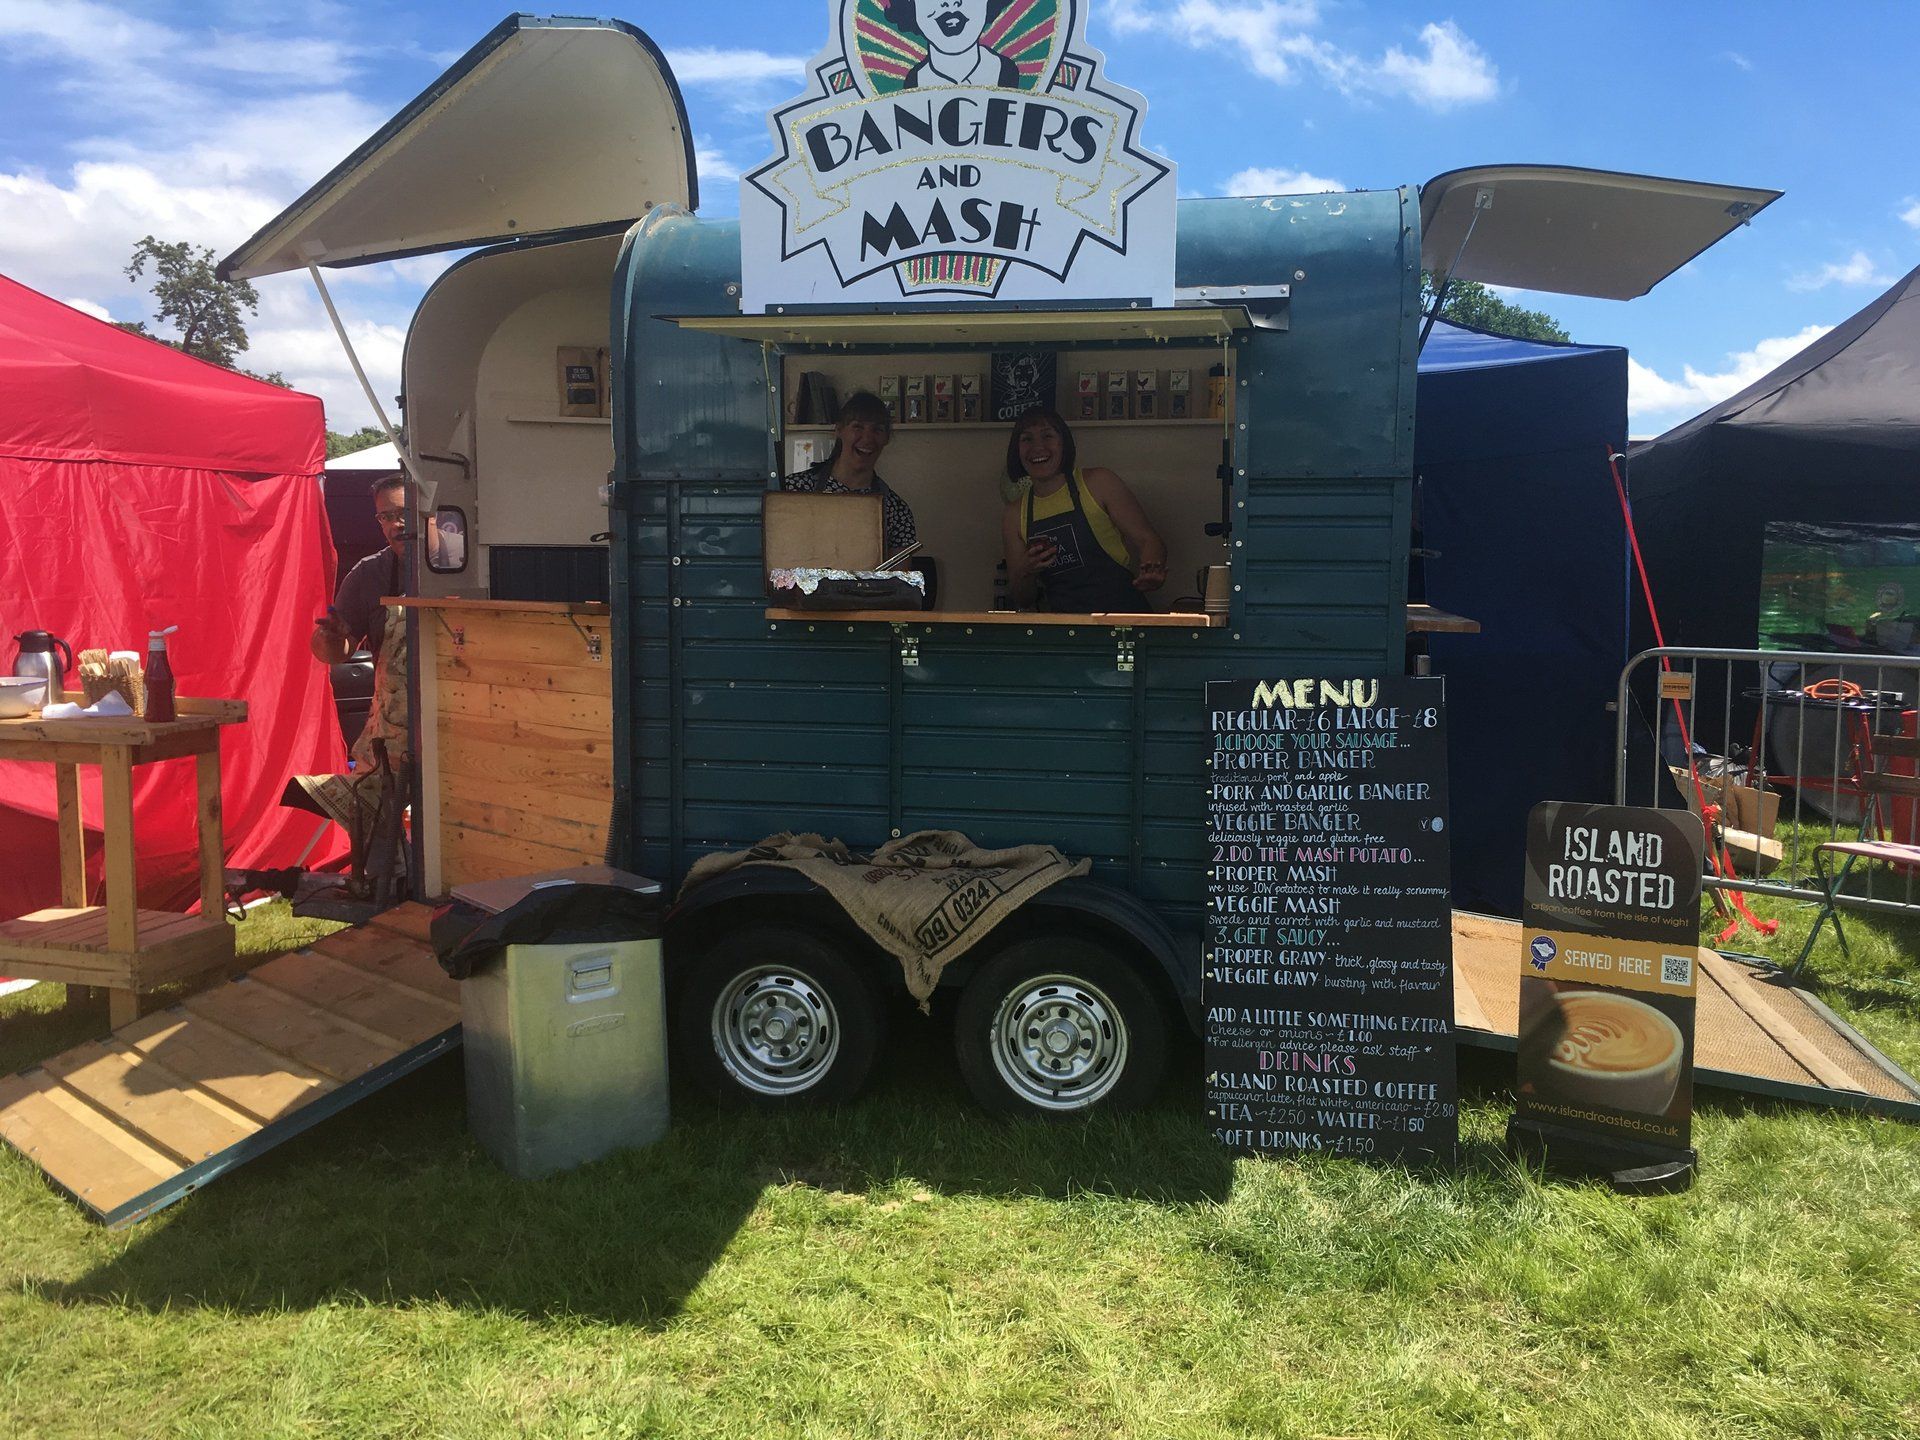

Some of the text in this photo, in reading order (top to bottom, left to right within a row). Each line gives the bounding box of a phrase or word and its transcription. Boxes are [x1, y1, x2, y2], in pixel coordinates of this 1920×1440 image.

[805, 97, 1103, 173] BANGERS
[916, 164, 981, 190] AND
[861, 197, 1041, 262] MASH
[1252, 679, 1378, 709] MENU
[1291, 733, 1329, 750] YOUR
[1213, 750, 1376, 770] PROPER BANGER
[1267, 772, 1292, 785] pork
[1295, 770, 1315, 780] and
[1318, 770, 1348, 783] apple
[1213, 783, 1430, 801] PORK AND GARLIC BANGER
[1208, 801, 1349, 817] infused with roasted garlic
[1213, 813, 1361, 831] VEGGIE BANGER
[1208, 832, 1386, 848] deliciously veggie and gluten free
[1564, 826, 1663, 869] ISLAND
[1258, 847, 1289, 862] THE
[1294, 847, 1344, 863] MASH
[1215, 866, 1338, 882] PROPER MASH
[1208, 884, 1225, 893] we
[1227, 884, 1249, 893] use
[1275, 883, 1314, 895] potatoes
[1318, 883, 1331, 895] to
[1332, 885, 1359, 895] make
[1362, 885, 1371, 895] it
[1373, 885, 1402, 899] really
[1405, 887, 1450, 899] scrummy
[1548, 864, 1674, 910] ROASTED
[952, 880, 991, 923] 0324
[1215, 896, 1341, 914] VEGGIE MASH
[1208, 914, 1441, 933] swede and carrot with garlic and mustard
[1531, 903, 1689, 928] artisan coffee from the isle of wight
[1214, 948, 1273, 965] PROPER
[1400, 959, 1420, 970] and
[1420, 959, 1448, 977] tasty
[1564, 948, 1612, 971] SERVED
[1618, 956, 1652, 976] HERE
[1213, 968, 1270, 985] VEGGIE
[1324, 974, 1367, 994] bursting
[1372, 978, 1396, 989] with
[1399, 980, 1441, 994] flavour
[1207, 1008, 1236, 1023] ADD
[1241, 1008, 1252, 1023] A
[1255, 1009, 1302, 1026] LITTLE
[1308, 1011, 1397, 1031] SOMETHING
[1211, 1024, 1255, 1036] Cheese
[1260, 1028, 1274, 1036] or
[1278, 1027, 1323, 1040] onions
[1232, 1039, 1276, 1053] allergen
[1280, 1040, 1317, 1051] advice
[1320, 1041, 1358, 1055] please
[1362, 1044, 1385, 1056] ask
[1259, 1051, 1357, 1076] DRINKS
[1213, 1071, 1438, 1100] ISLAND ROASTED COFFEE
[1217, 1103, 1253, 1122] TEA
[1297, 1094, 1318, 1107] flat
[1355, 1100, 1412, 1112] americano
[1527, 1100, 1679, 1137] www.islandroasted.co.uk
[1216, 1128, 1253, 1146] SOFT
[1260, 1130, 1322, 1150] DRINKS
